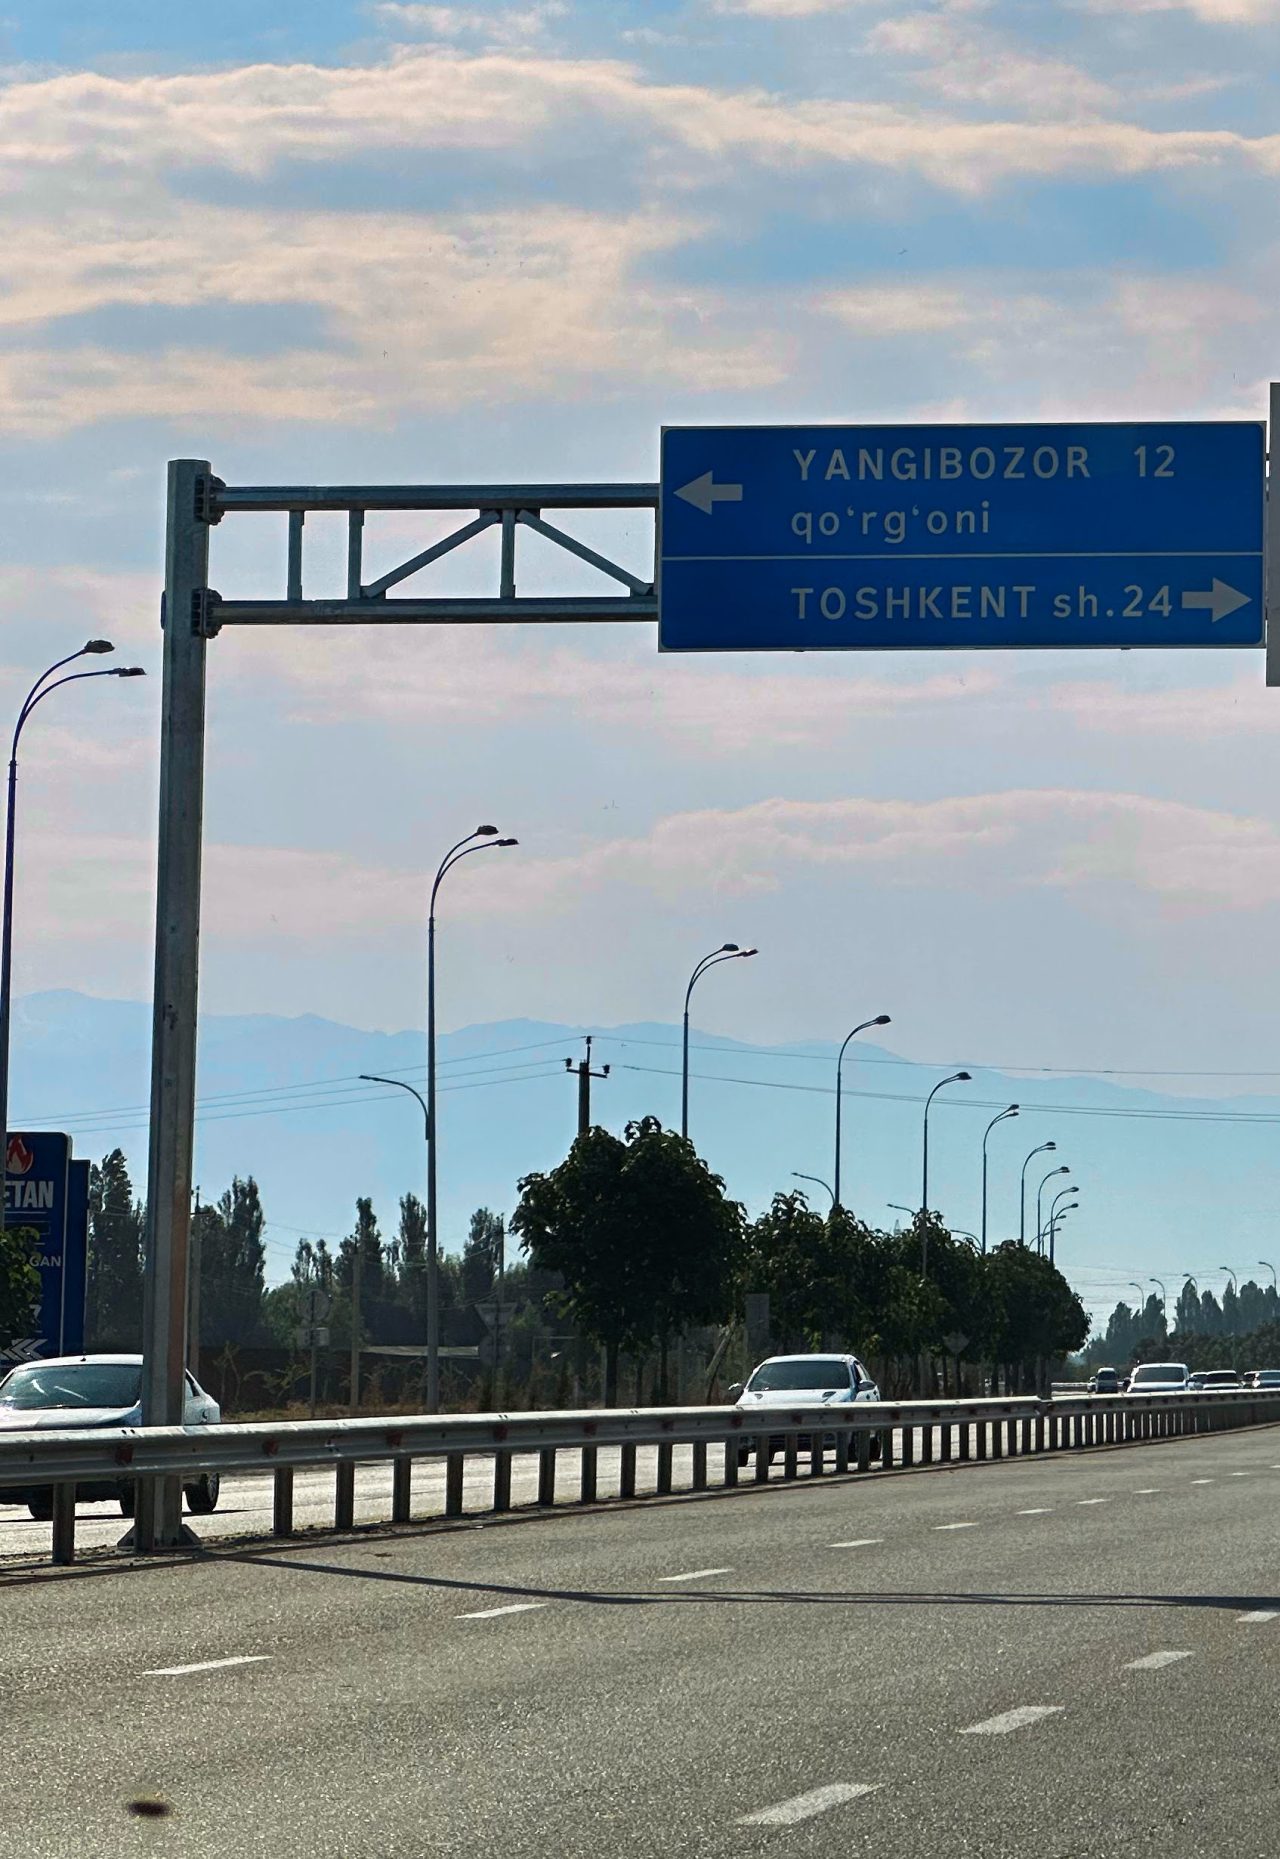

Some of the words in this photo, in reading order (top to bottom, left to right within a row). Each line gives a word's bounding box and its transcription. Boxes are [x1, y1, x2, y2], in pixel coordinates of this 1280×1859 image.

[792, 446, 1091, 481] YANGIBOZOR
[1134, 445, 1176, 478] 12
[791, 585, 1037, 620] TOSHKENT
